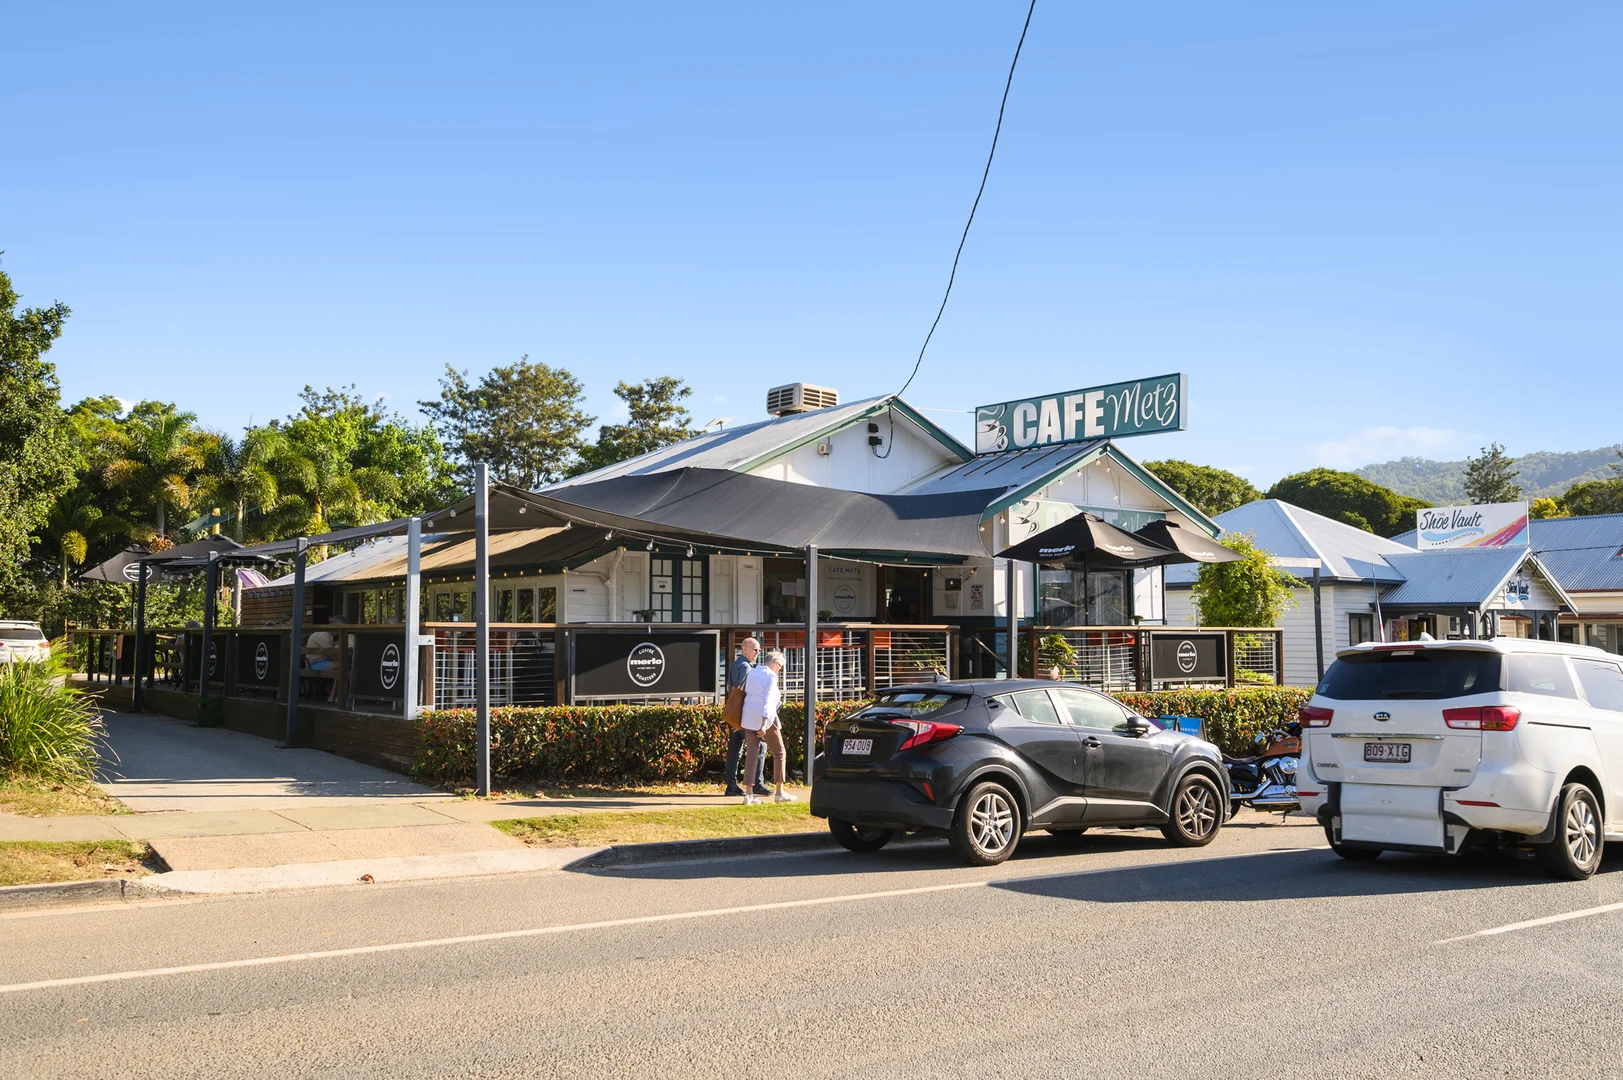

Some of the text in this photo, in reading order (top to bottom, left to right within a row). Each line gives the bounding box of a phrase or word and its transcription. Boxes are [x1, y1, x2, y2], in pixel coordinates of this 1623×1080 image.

[1013, 382, 1177, 447] CAFE Metz
[1420, 509, 1483, 530] Shoe Vault
[1039, 545, 1075, 553] merlo
[630, 658, 662, 666] merlo
